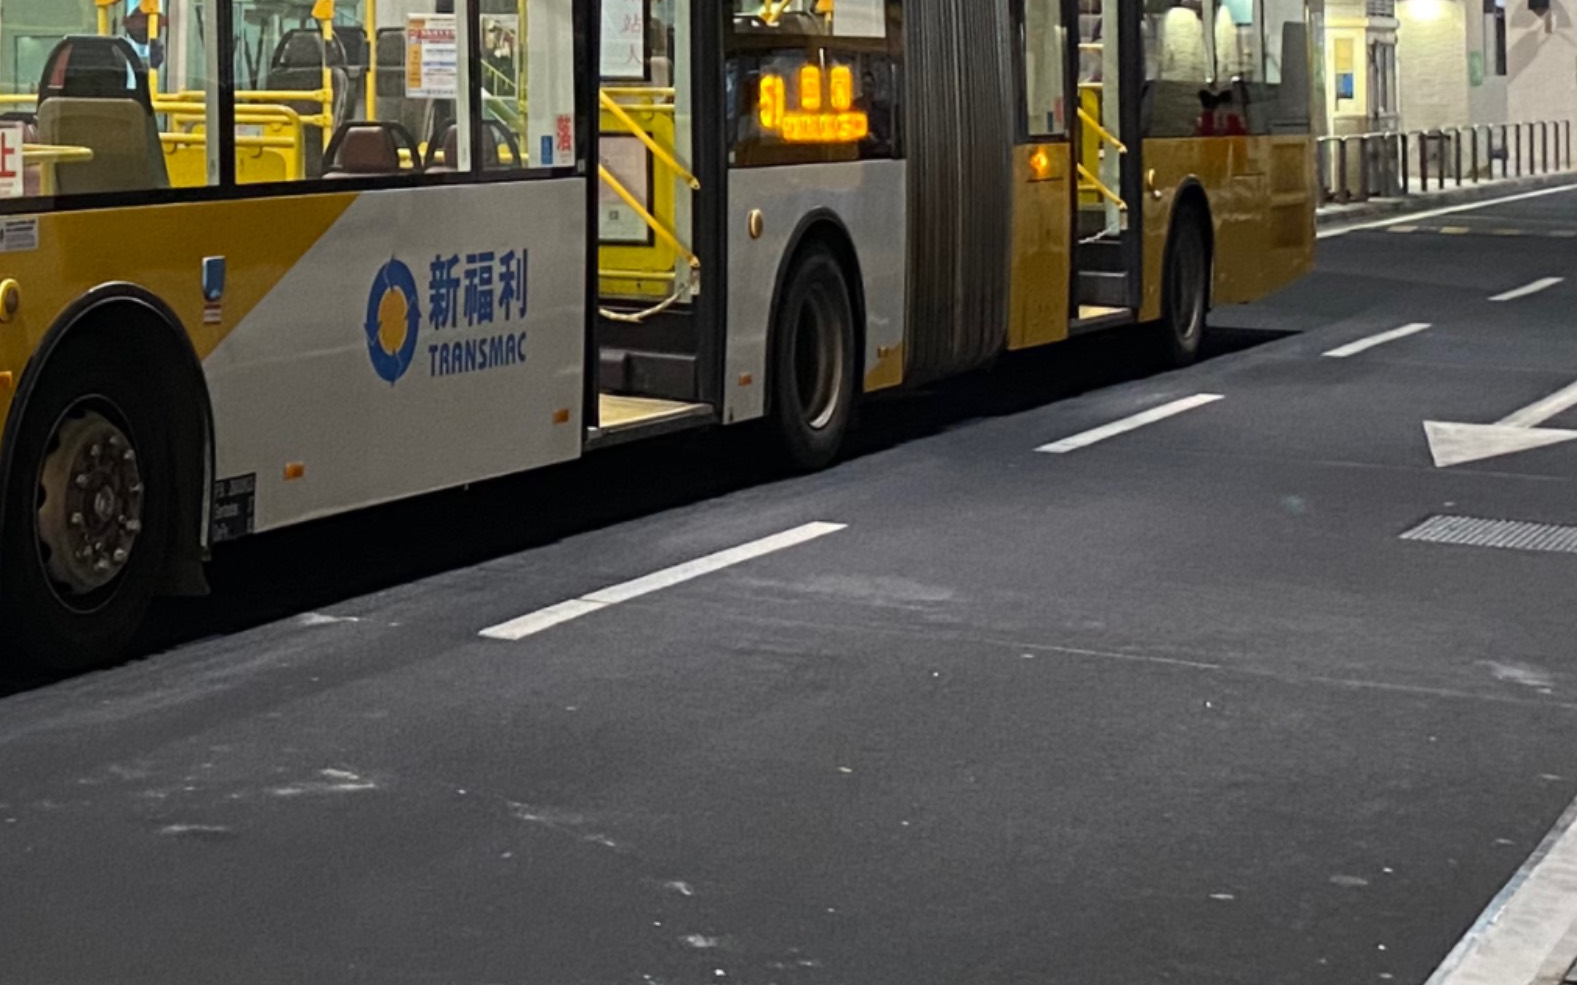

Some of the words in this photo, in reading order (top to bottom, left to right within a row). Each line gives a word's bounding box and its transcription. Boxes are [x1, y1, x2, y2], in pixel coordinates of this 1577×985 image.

[429, 248, 528, 331] 新福利
[428, 331, 527, 377] TRANSMAC
